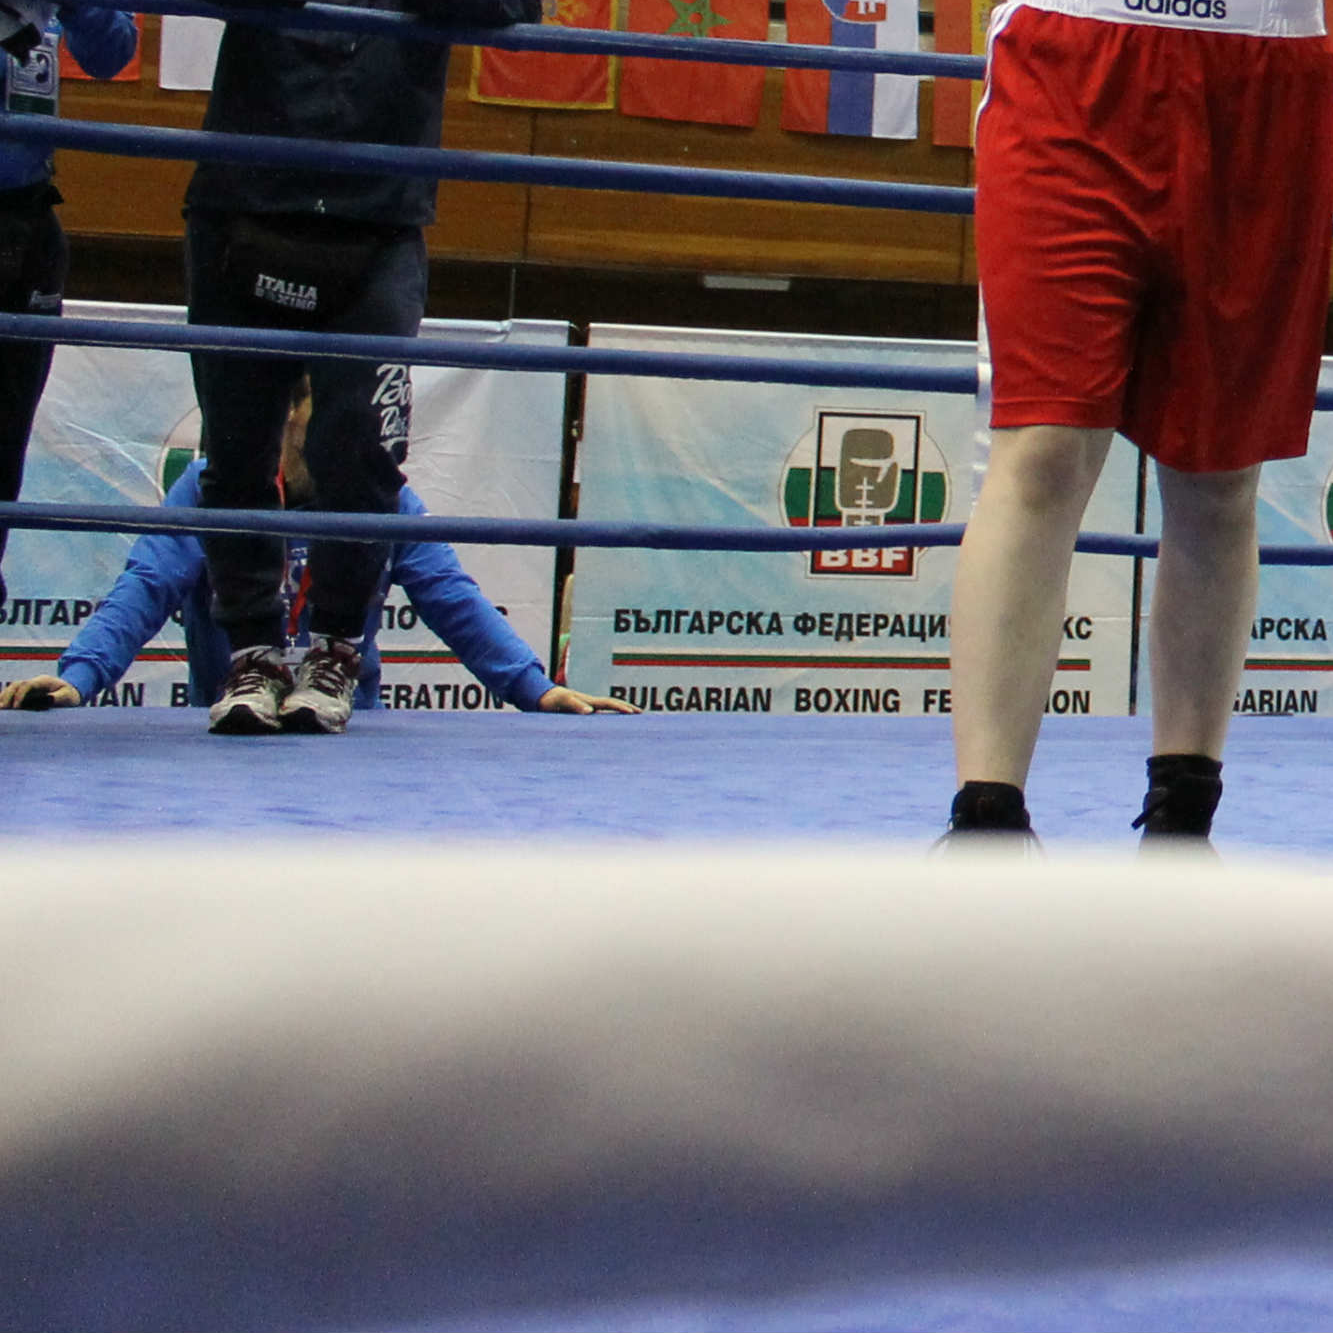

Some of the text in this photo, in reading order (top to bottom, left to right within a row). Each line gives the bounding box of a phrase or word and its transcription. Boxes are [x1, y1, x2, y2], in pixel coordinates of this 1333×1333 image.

[256, 273, 318, 301] ITALIA
[820, 547, 909, 569] BBF
[613, 608, 950, 642] БЪЛГАРСКА ФЕДЕРАЦИ
[794, 687, 900, 714] BOXING
